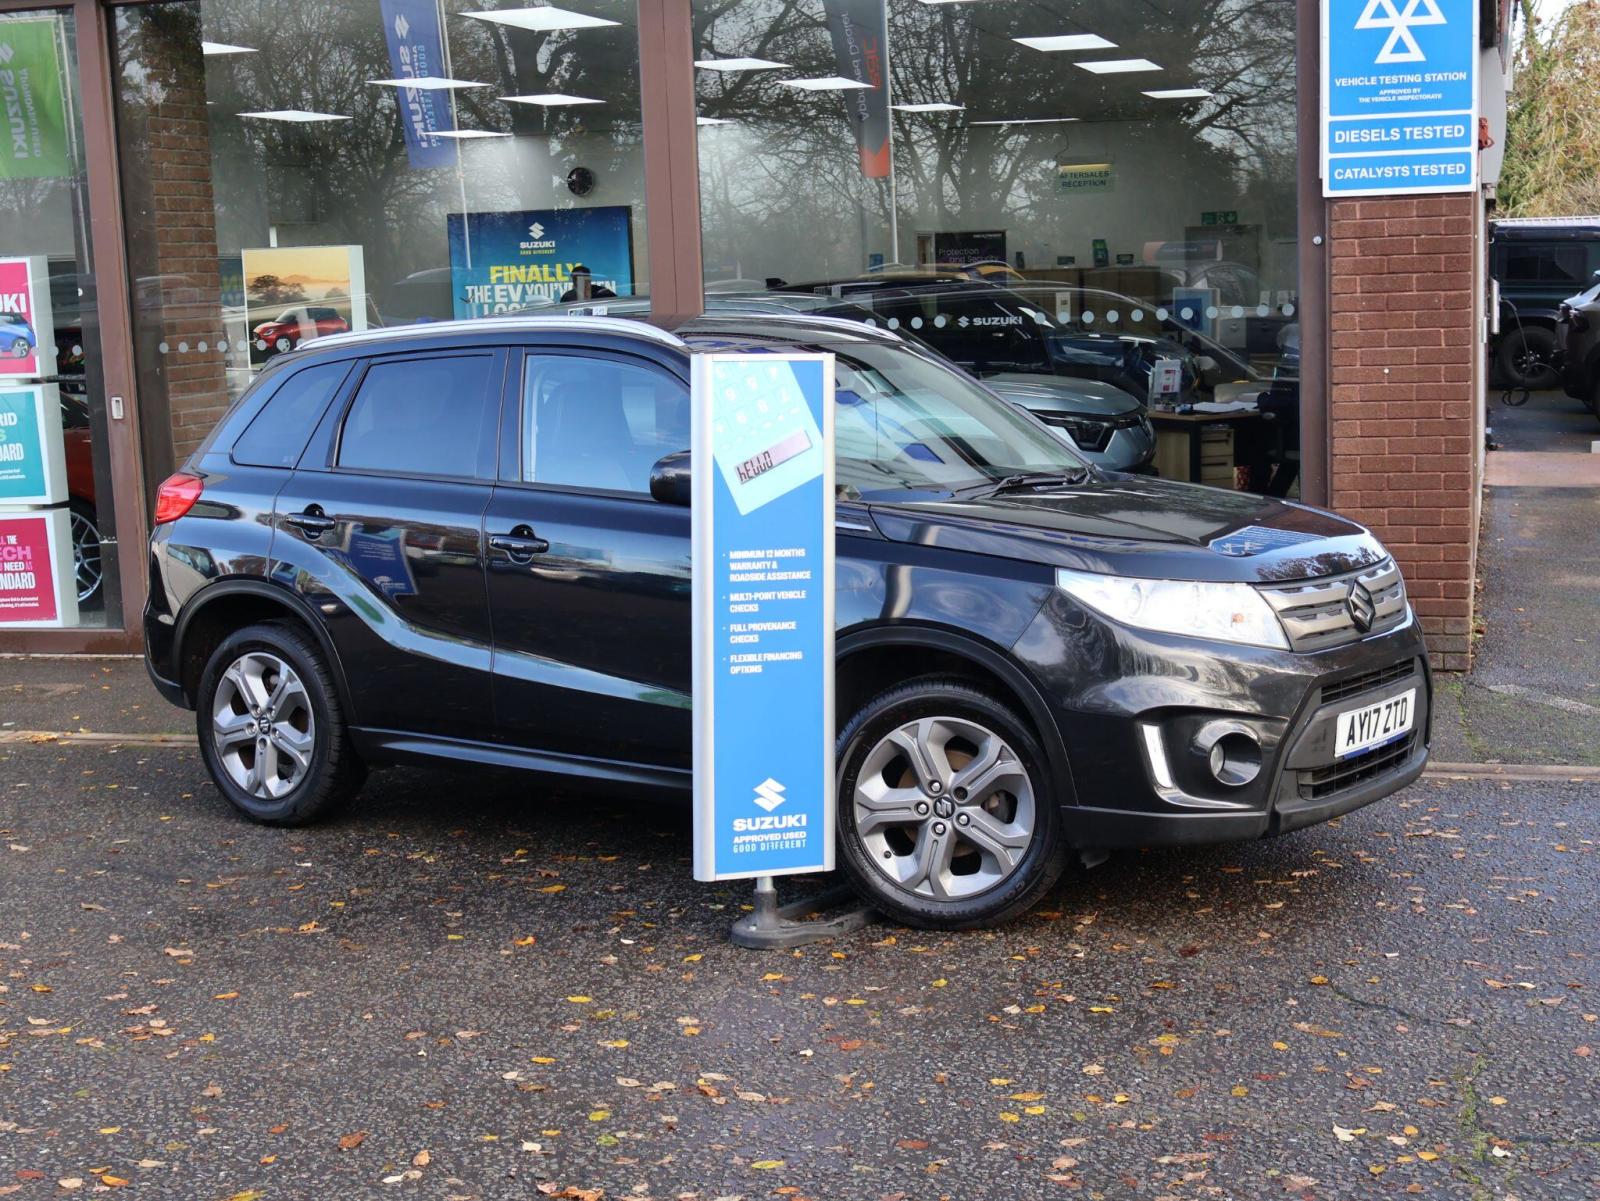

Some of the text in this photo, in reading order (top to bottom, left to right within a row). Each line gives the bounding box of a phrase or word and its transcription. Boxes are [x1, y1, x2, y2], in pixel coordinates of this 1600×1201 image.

[1335, 72, 1467, 87] VEHICLE TESTING STATION
[1397, 93, 1442, 101] INSPECTORATE
[1335, 125, 1465, 143] DIESELS TESTED
[1334, 163, 1466, 180] CATALYSTS TESTED
[1062, 179, 1106, 188] RECEPTION
[519, 240, 556, 249] SUZUKI
[938, 248, 980, 256] Protection
[490, 262, 583, 284] FINALLY
[465, 285, 492, 304] THE
[494, 284, 523, 303] EV
[0, 293, 27, 313] KI
[973, 316, 1023, 326] SUZUKI
[7, 535, 17, 545] THE
[730, 549, 764, 559] MINIMUM
[774, 548, 806, 558] MONTHS
[4, 561, 25, 571] NEED
[730, 561, 771, 570] WARRANTY
[730, 571, 811, 582] ROADSIDE ASSISTANCE
[730, 590, 806, 601] MULTI-POINT VEHICLE
[730, 604, 759, 613] CHECKS
[730, 621, 796, 632] FULL PROVENANCE
[730, 634, 759, 643] CHECKS
[730, 651, 803, 662] FLEXIBLE FINANCING
[730, 665, 763, 674] OPTIONS
[1346, 697, 1408, 746] AY17 ZTD
[733, 814, 807, 831] SUZUKI
[733, 831, 806, 844] APPROVED USED
[733, 839, 806, 853] GOOD DIFFERENT
